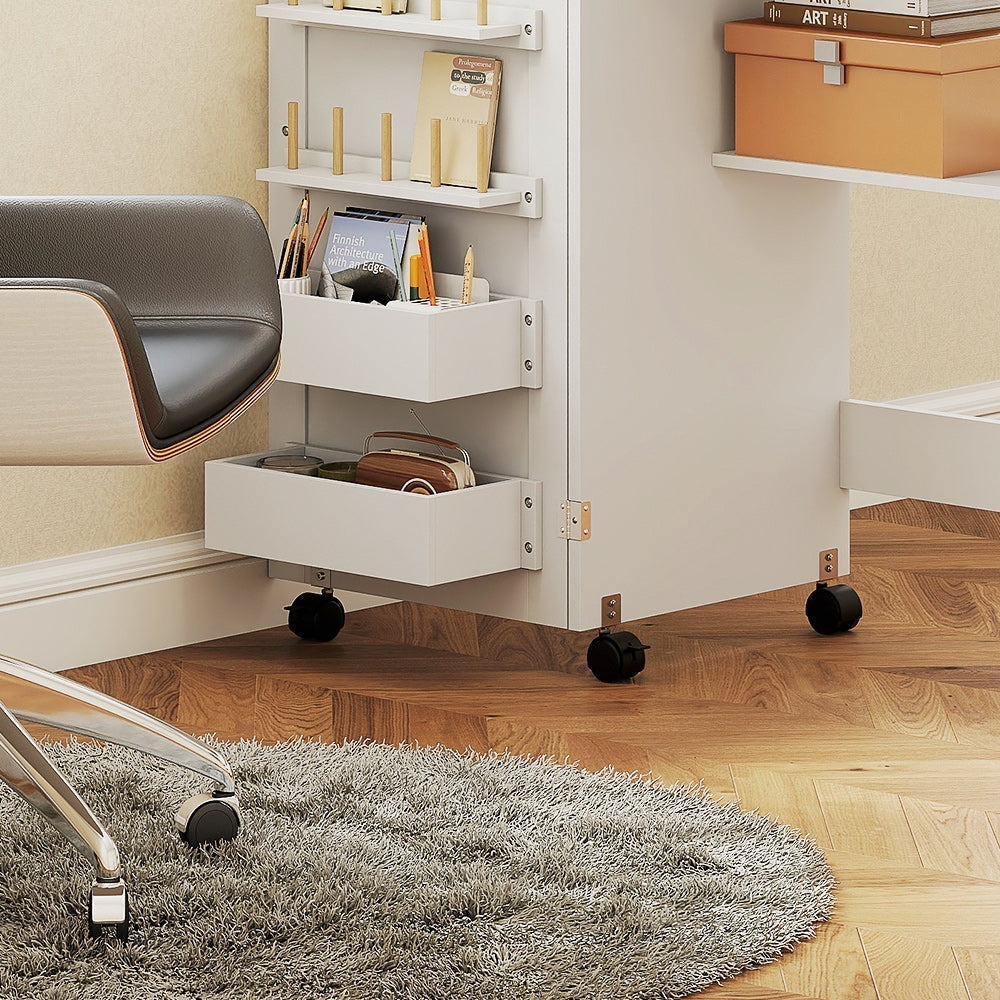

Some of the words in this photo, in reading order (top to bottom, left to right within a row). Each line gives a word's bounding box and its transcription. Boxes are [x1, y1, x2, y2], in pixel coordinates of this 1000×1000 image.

[802, 9, 829, 26] ART
[461, 72, 470, 80] the
[471, 73, 485, 83] study
[332, 233, 365, 247] Finnish
[329, 245, 384, 261] Architecture
[328, 257, 347, 267] with
[349, 261, 360, 270] an
[362, 261, 385, 274] Edge
